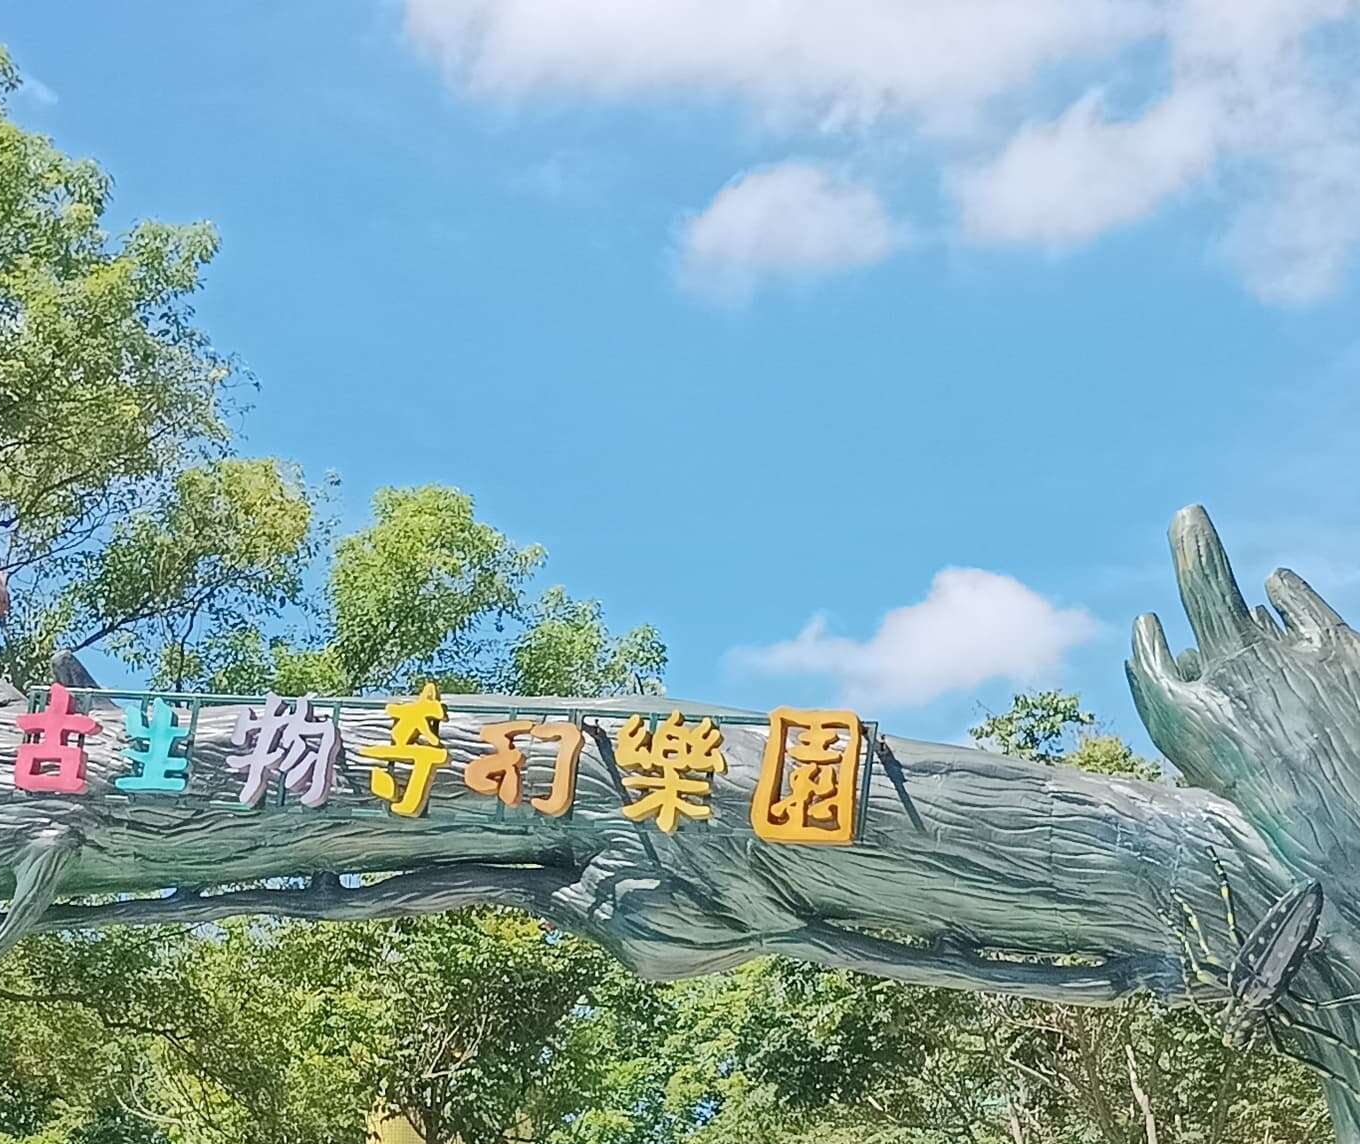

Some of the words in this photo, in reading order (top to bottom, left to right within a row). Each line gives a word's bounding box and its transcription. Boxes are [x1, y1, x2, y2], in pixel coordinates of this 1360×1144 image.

[14, 682, 862, 846] 古生物奇幻樂園
